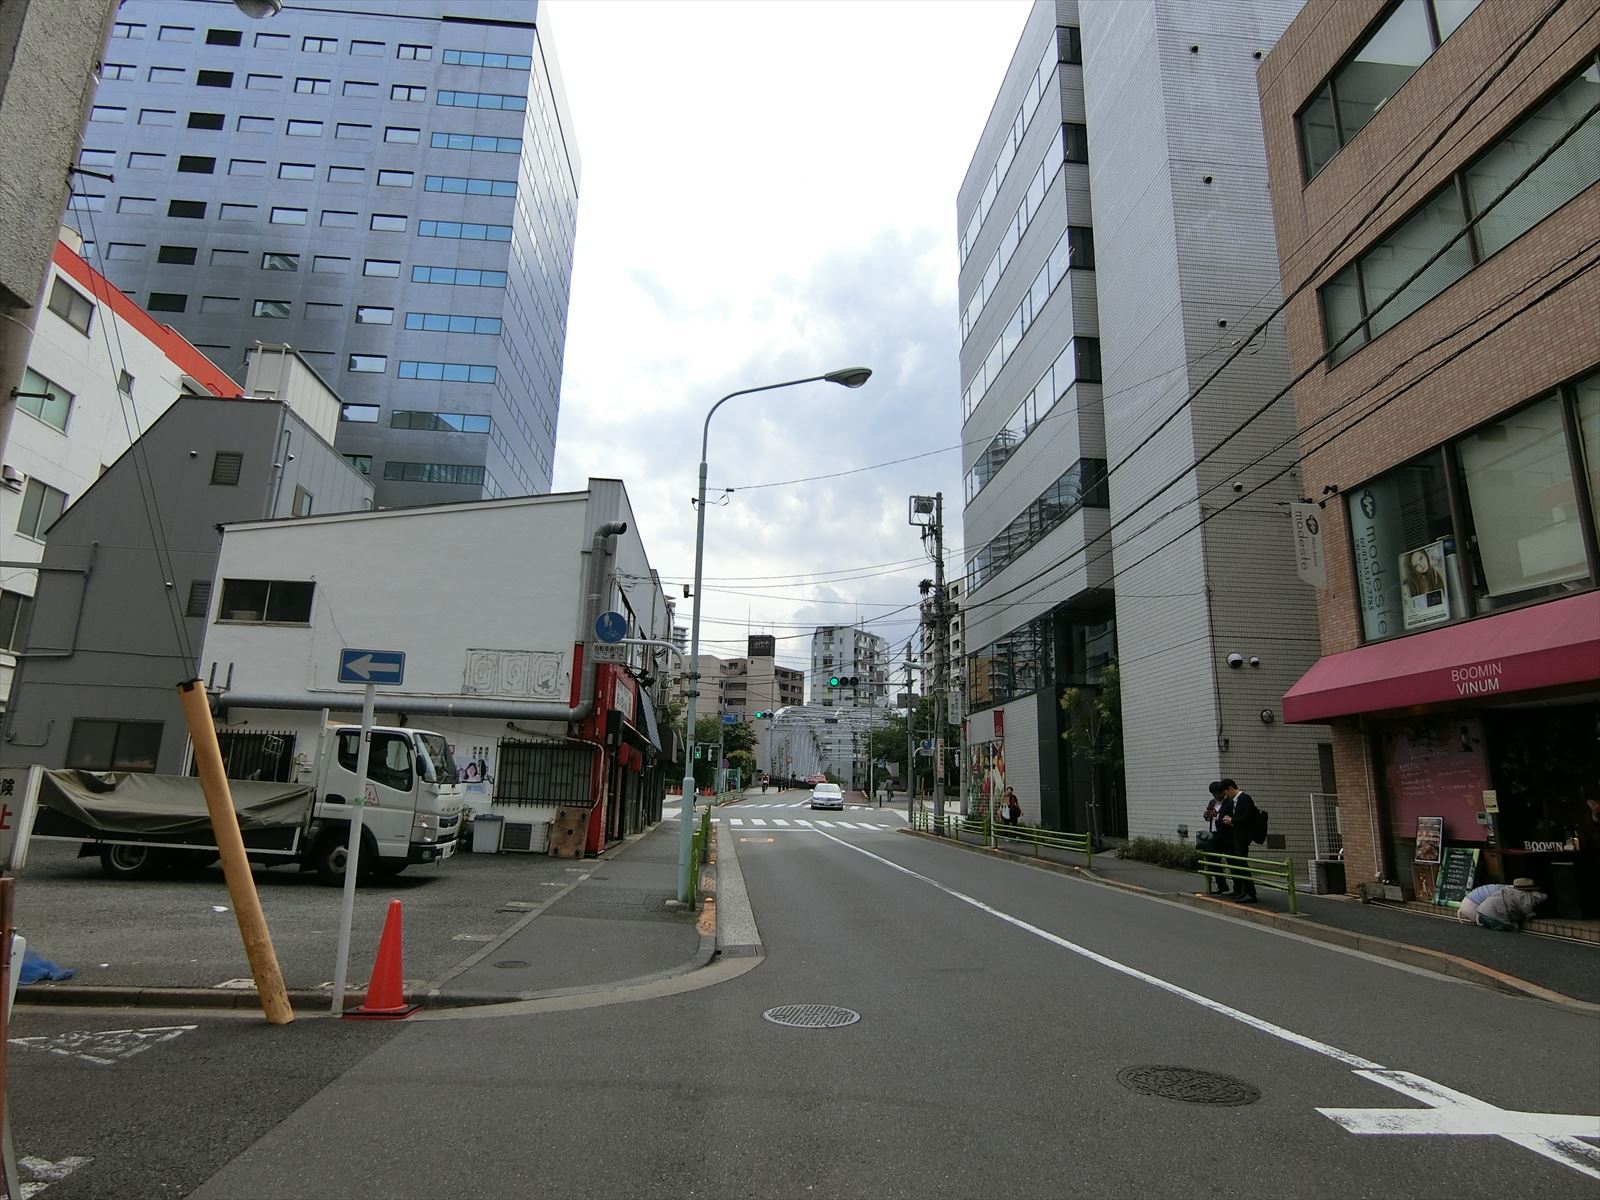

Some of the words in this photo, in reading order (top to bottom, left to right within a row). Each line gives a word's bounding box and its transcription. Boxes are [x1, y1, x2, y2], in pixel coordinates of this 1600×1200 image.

[1296, 511, 1310, 570] modeste
[1366, 525, 1392, 635] modeste
[1451, 662, 1502, 682] BOOMIN
[1456, 677, 1500, 695] VINUM
[0, 778, 15, 796] 険
[1523, 840, 1563, 852] BOOMIN
